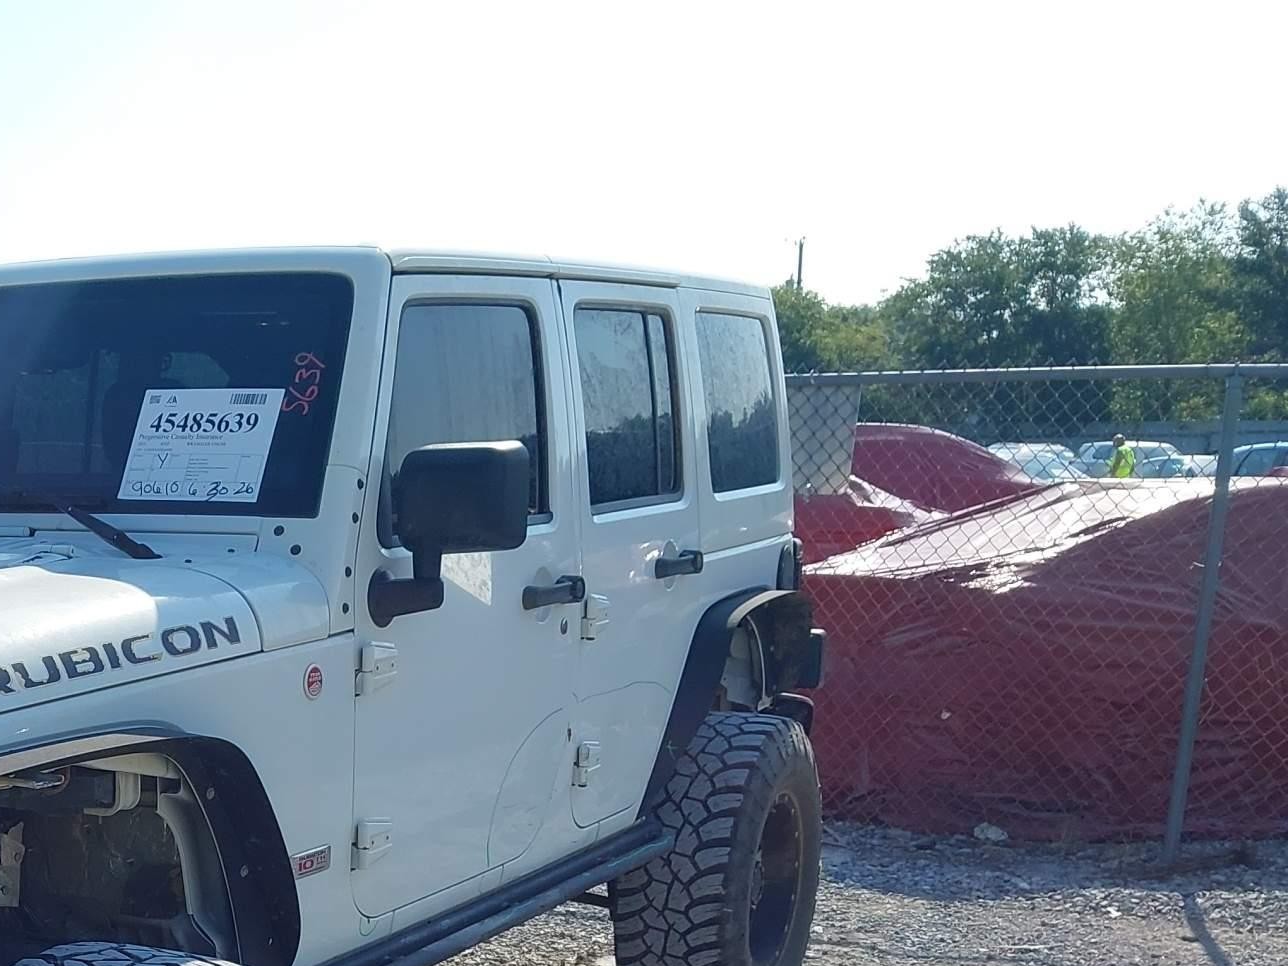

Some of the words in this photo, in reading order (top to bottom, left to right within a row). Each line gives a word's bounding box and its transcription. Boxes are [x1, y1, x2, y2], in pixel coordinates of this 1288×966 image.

[280, 352, 326, 416] 5639
[149, 411, 260, 434] 45485639
[157, 452, 169, 469] Y
[132, 480, 179, 496] 90610
